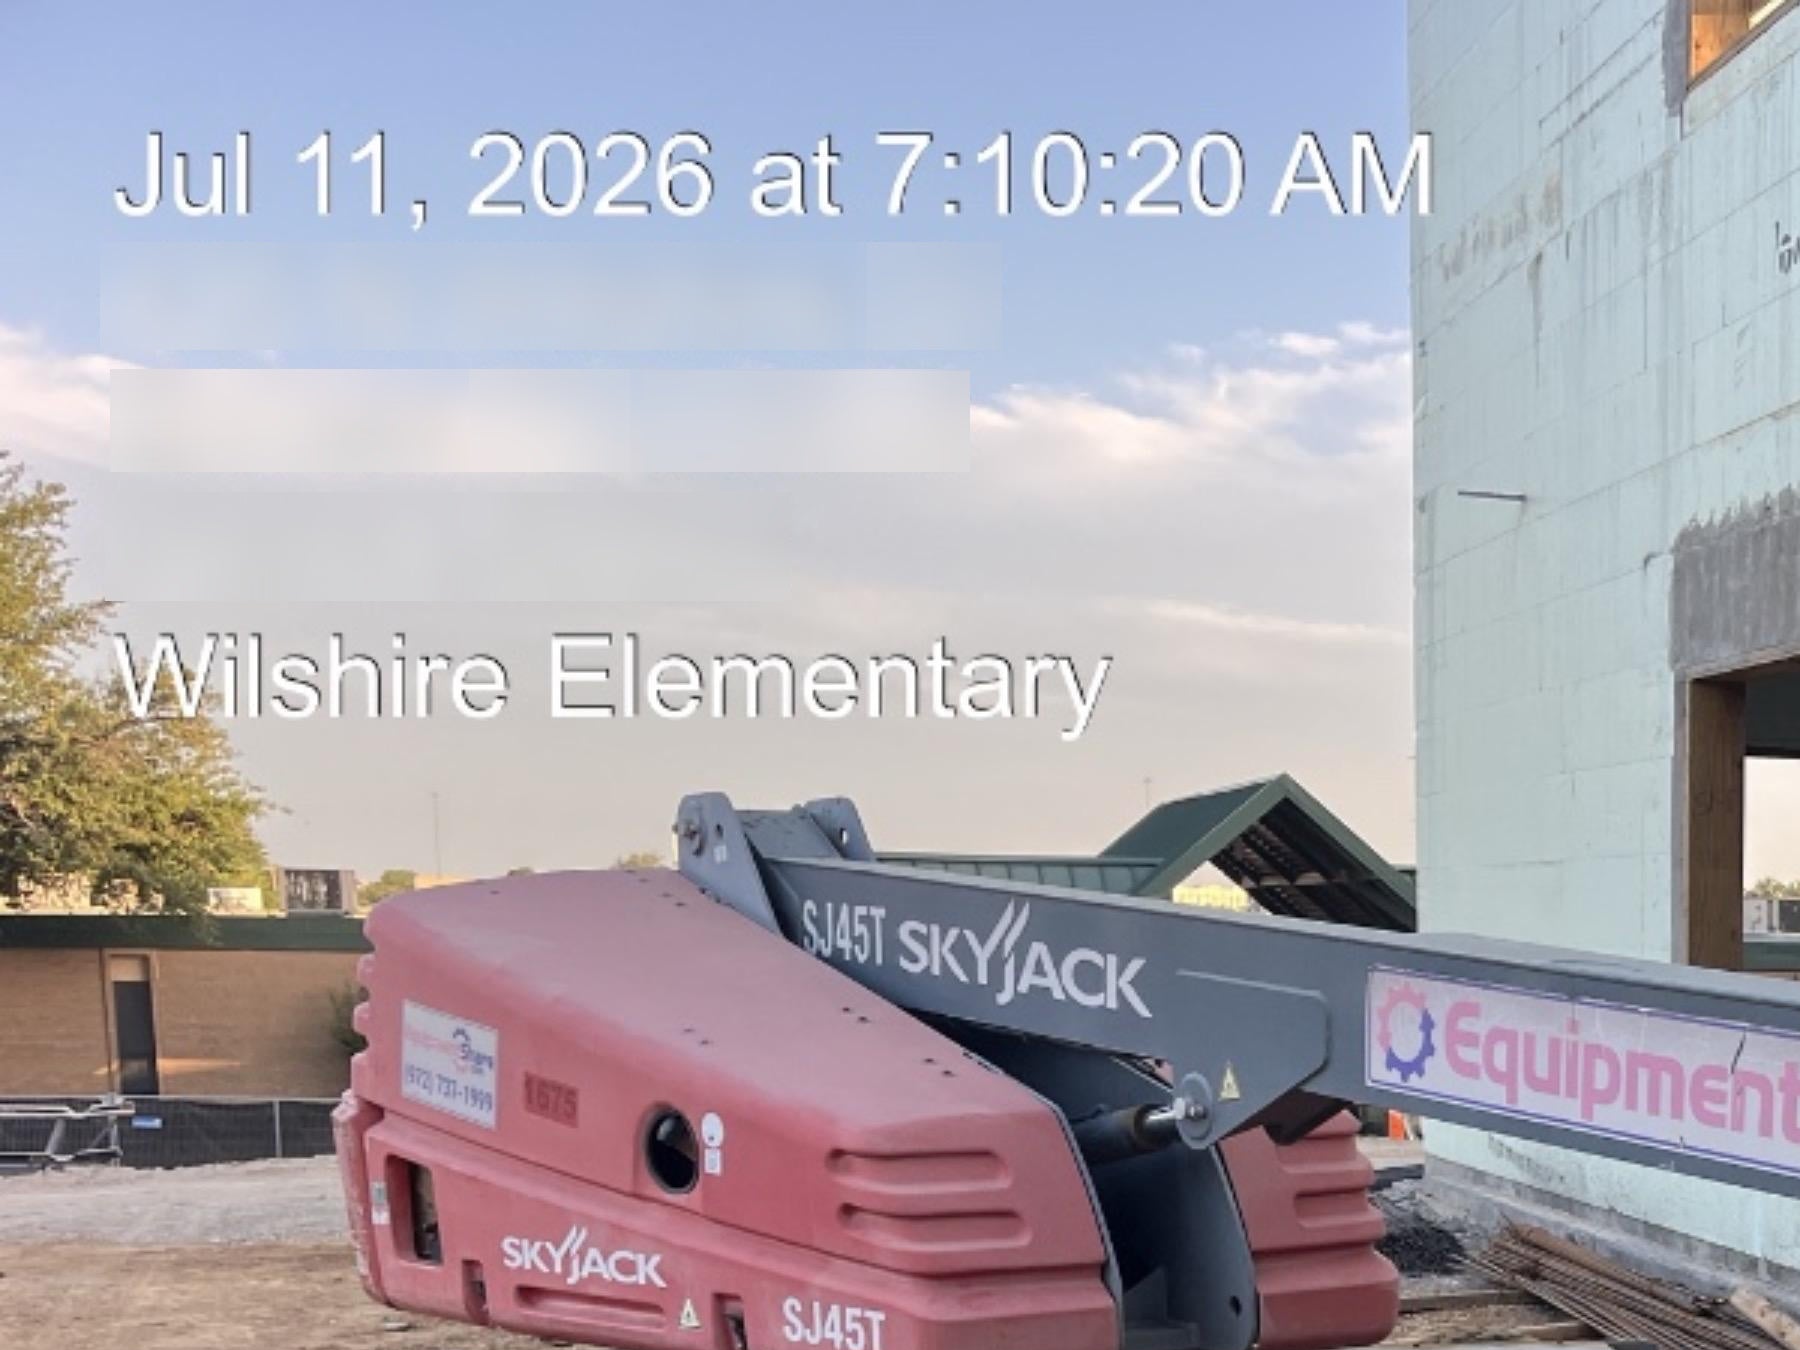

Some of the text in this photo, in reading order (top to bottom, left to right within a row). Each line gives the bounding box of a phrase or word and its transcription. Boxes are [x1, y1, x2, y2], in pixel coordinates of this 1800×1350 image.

[802, 899, 887, 967] SJ45T
[899, 897, 1153, 1019] SKYJACK
[524, 1072, 579, 1128] 1675
[502, 1224, 667, 1288] SKYJACK
